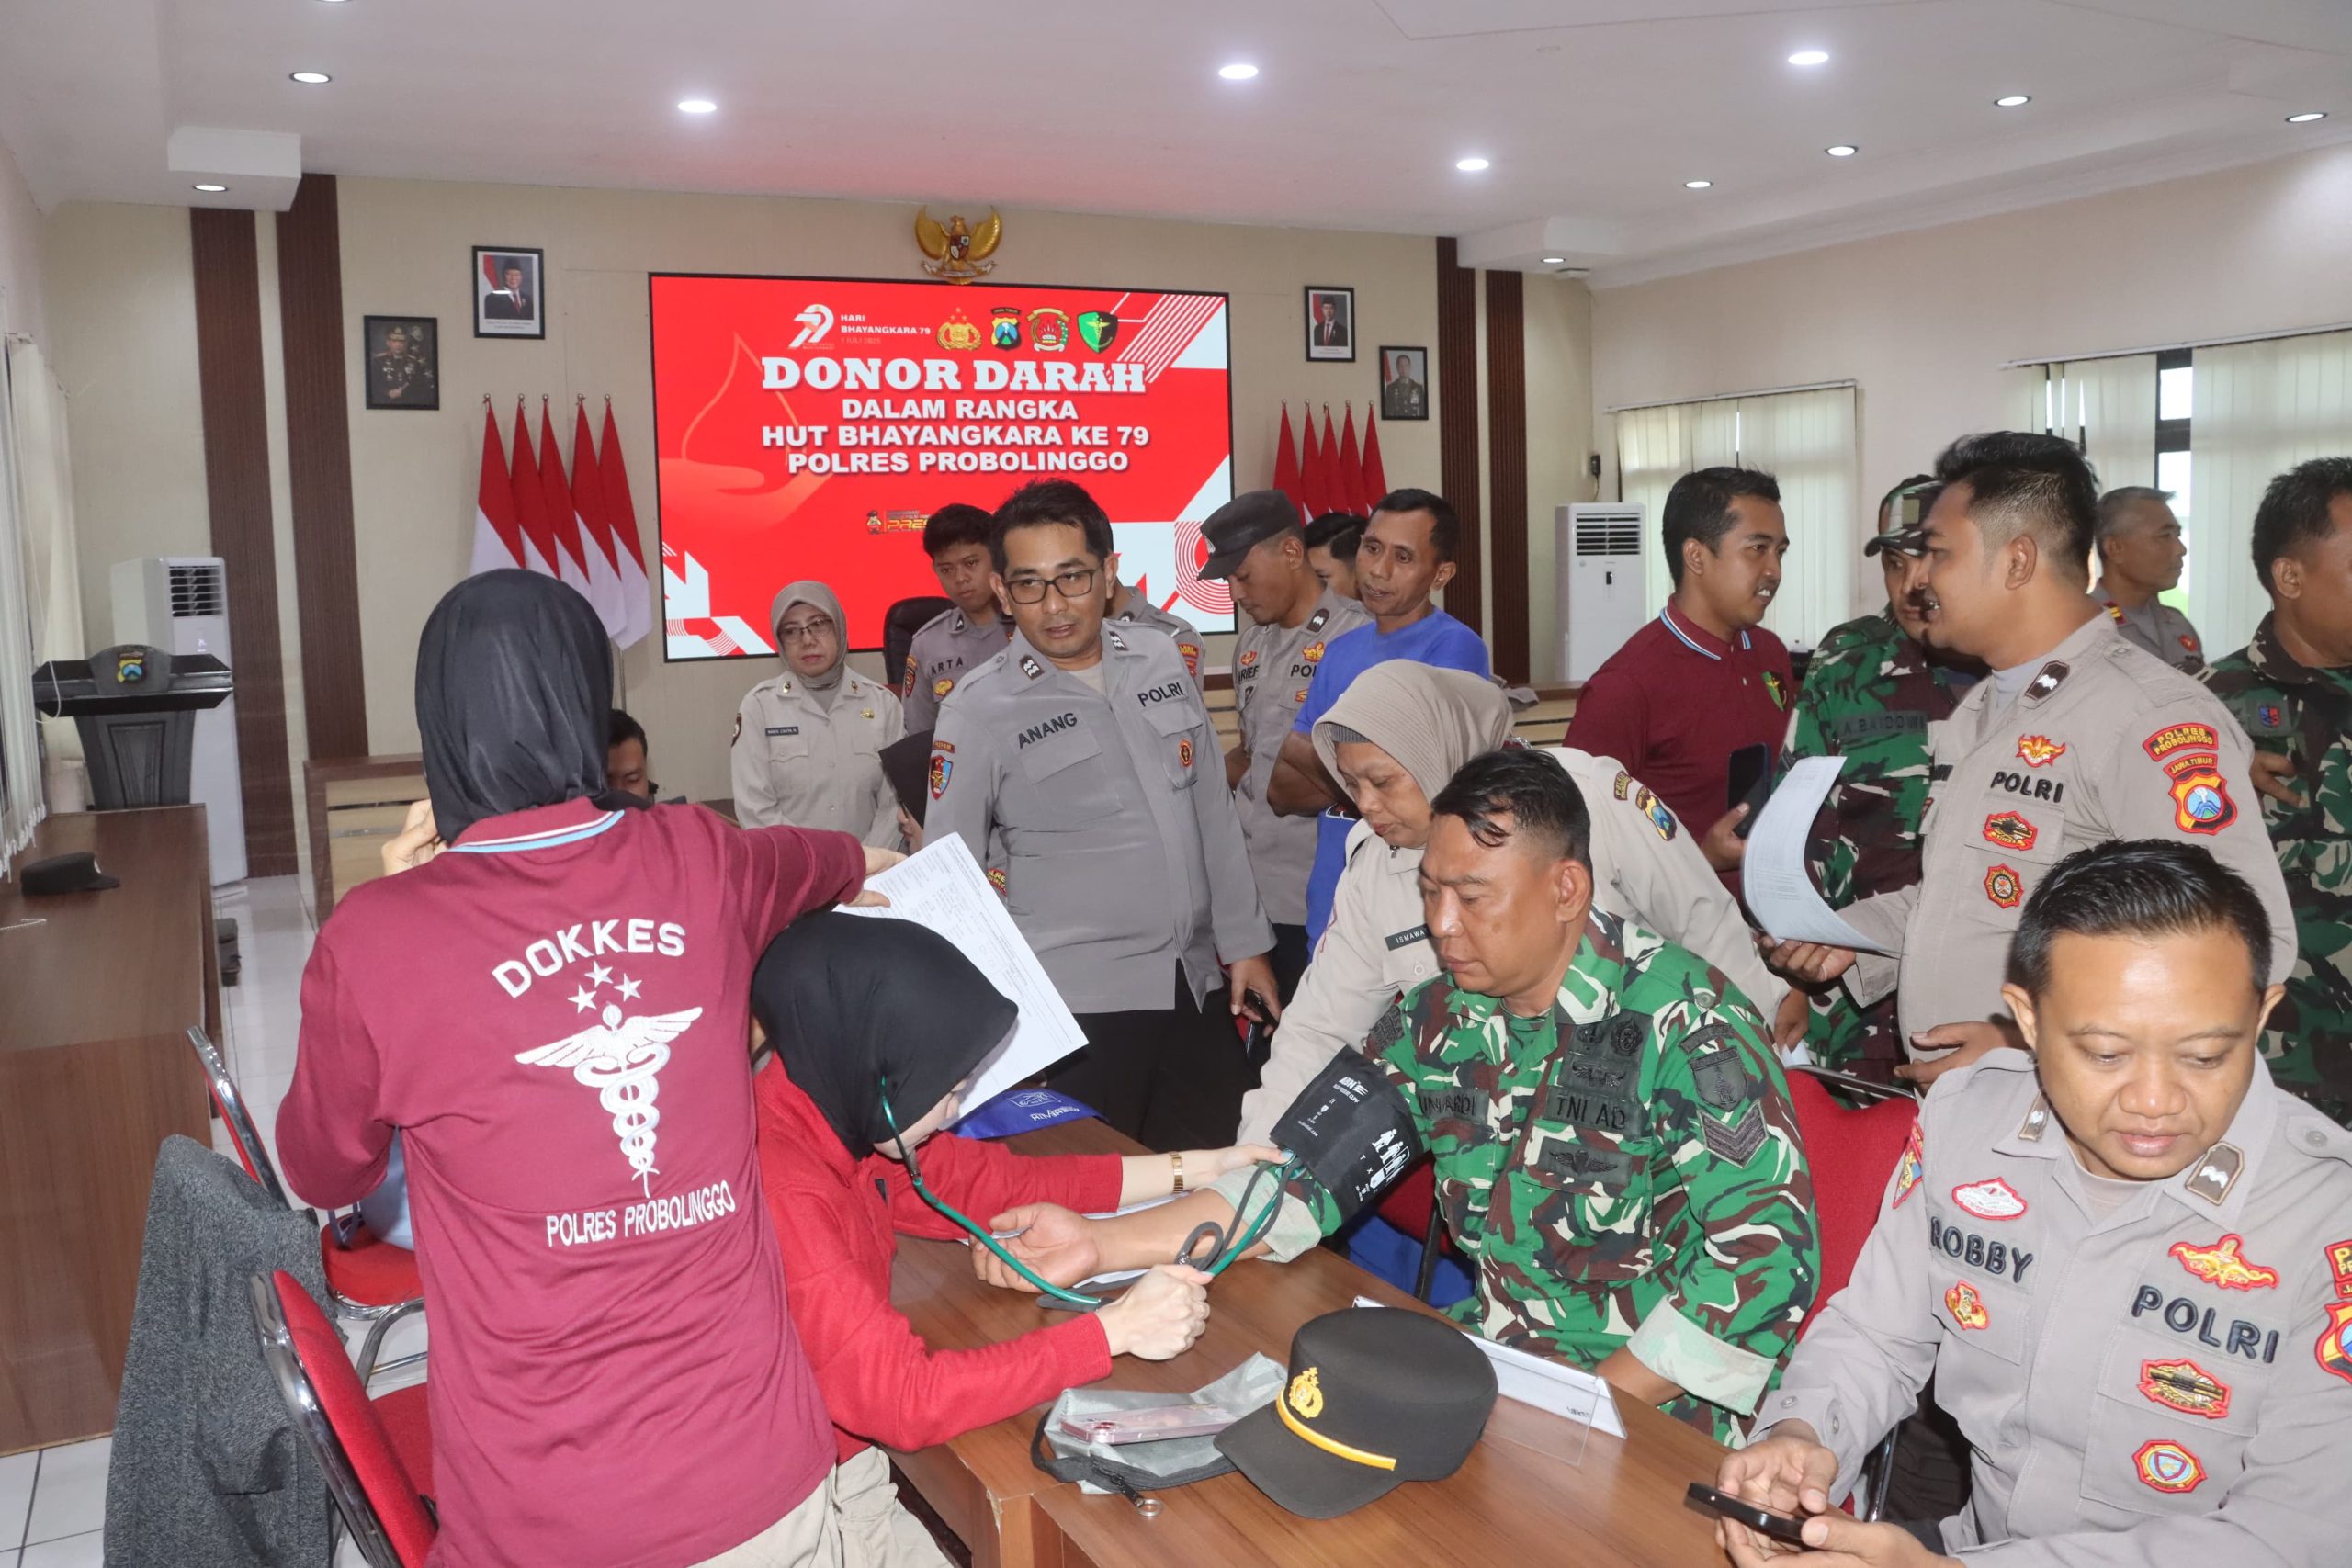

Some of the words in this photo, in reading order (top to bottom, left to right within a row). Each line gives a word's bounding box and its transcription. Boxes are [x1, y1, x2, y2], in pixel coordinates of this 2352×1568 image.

[841, 314, 865, 322] HARI
[841, 325, 917, 334] BHAYANGKARA
[761, 356, 962, 390] DONOR
[973, 359, 1147, 393] DARAH
[842, 399, 946, 419] DALAM
[956, 400, 1079, 420] RANGKA
[762, 425, 828, 446] HUT
[838, 425, 1063, 446] BHAYANGKARA
[1071, 426, 1109, 445] KE
[1116, 426, 1149, 446] 79
[788, 451, 910, 474] POLRES
[919, 451, 1129, 472] PROBOLINGGO
[931, 656, 964, 676] ARTA
[1137, 682, 1184, 707] POLRI
[1018, 712, 1078, 750] ANANG
[2156, 727, 2206, 746] POLRES
[2154, 735, 2214, 755] PROBOLINGGO
[1990, 771, 2064, 804] POLRI
[492, 918, 686, 998] DOKKES
[1557, 1096, 1589, 1122] TNI
[1595, 1103, 1625, 1130] AD
[546, 1210, 616, 1247] POLRES
[624, 1180, 736, 1237] PROBOLINGGO
[2132, 1285, 2279, 1364] POLRI
